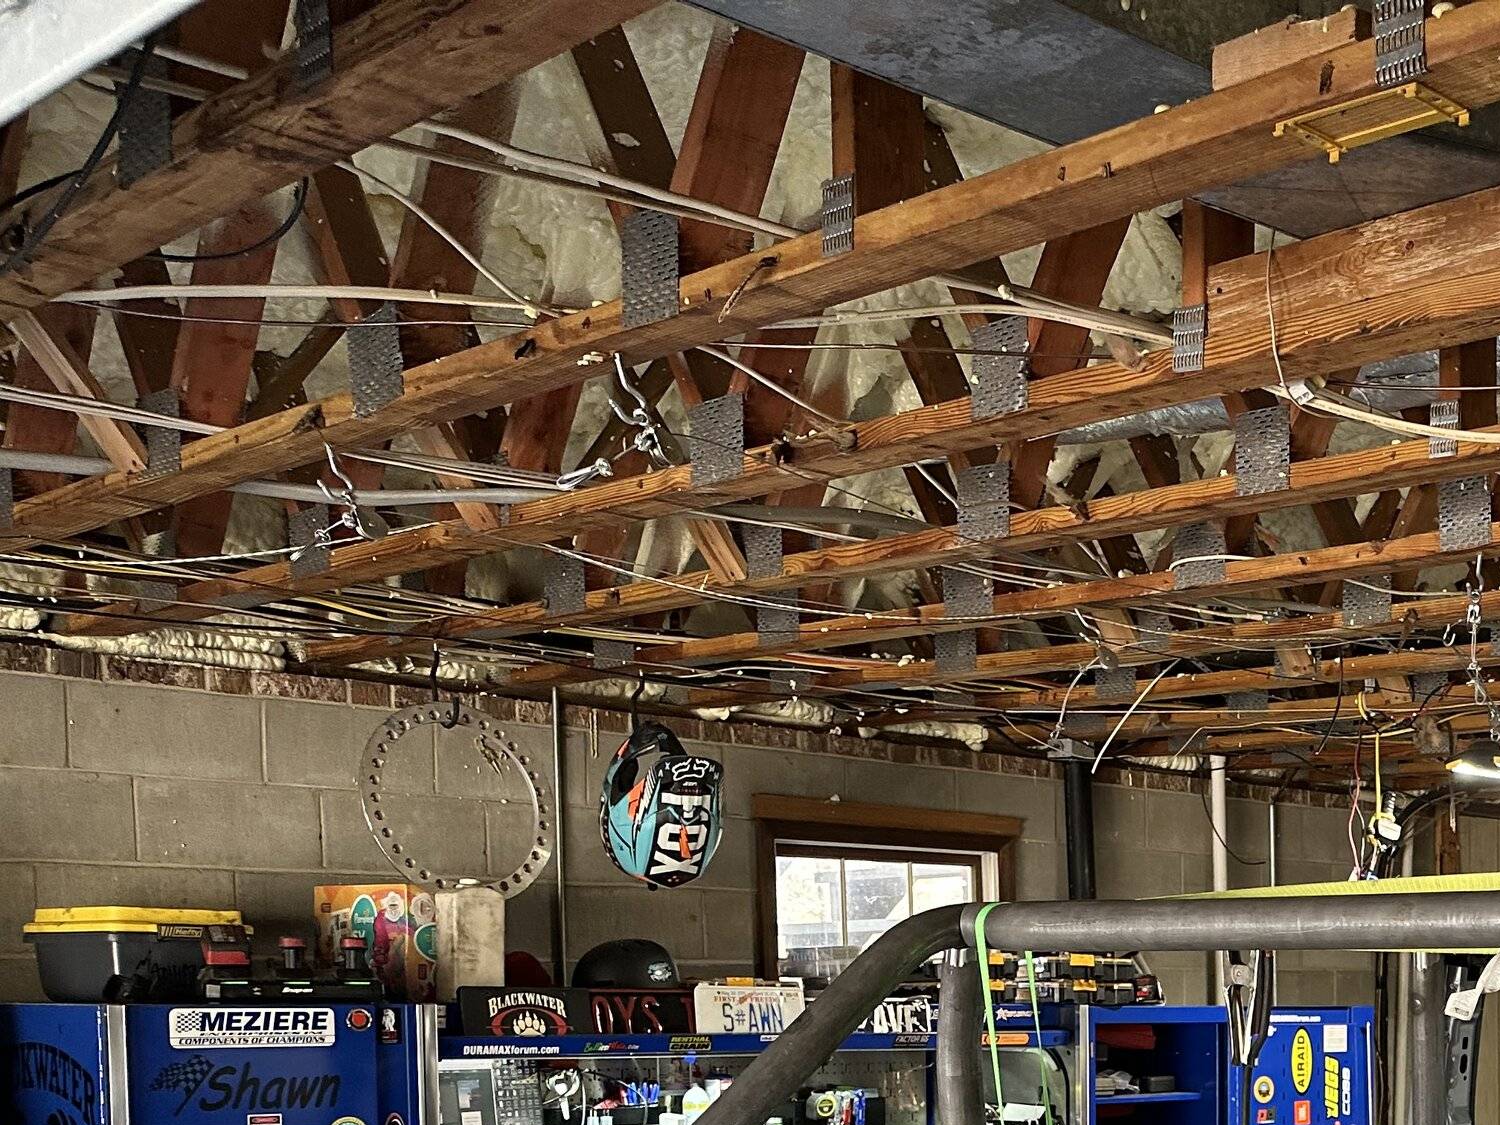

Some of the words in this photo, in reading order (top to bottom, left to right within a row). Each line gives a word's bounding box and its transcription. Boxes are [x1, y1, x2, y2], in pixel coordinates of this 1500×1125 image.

[488, 992, 567, 1018] BLACKWATER
[200, 1011, 329, 1032] MEZIERE
[179, 1037, 245, 1046] COMPONENTS
[266, 1036, 326, 1045] CHAMPIONS
[463, 1045, 560, 1055] DURAMAXforum.com
[1297, 1035, 1305, 1088] AIRAID
[200, 1061, 341, 1112] Shawn
